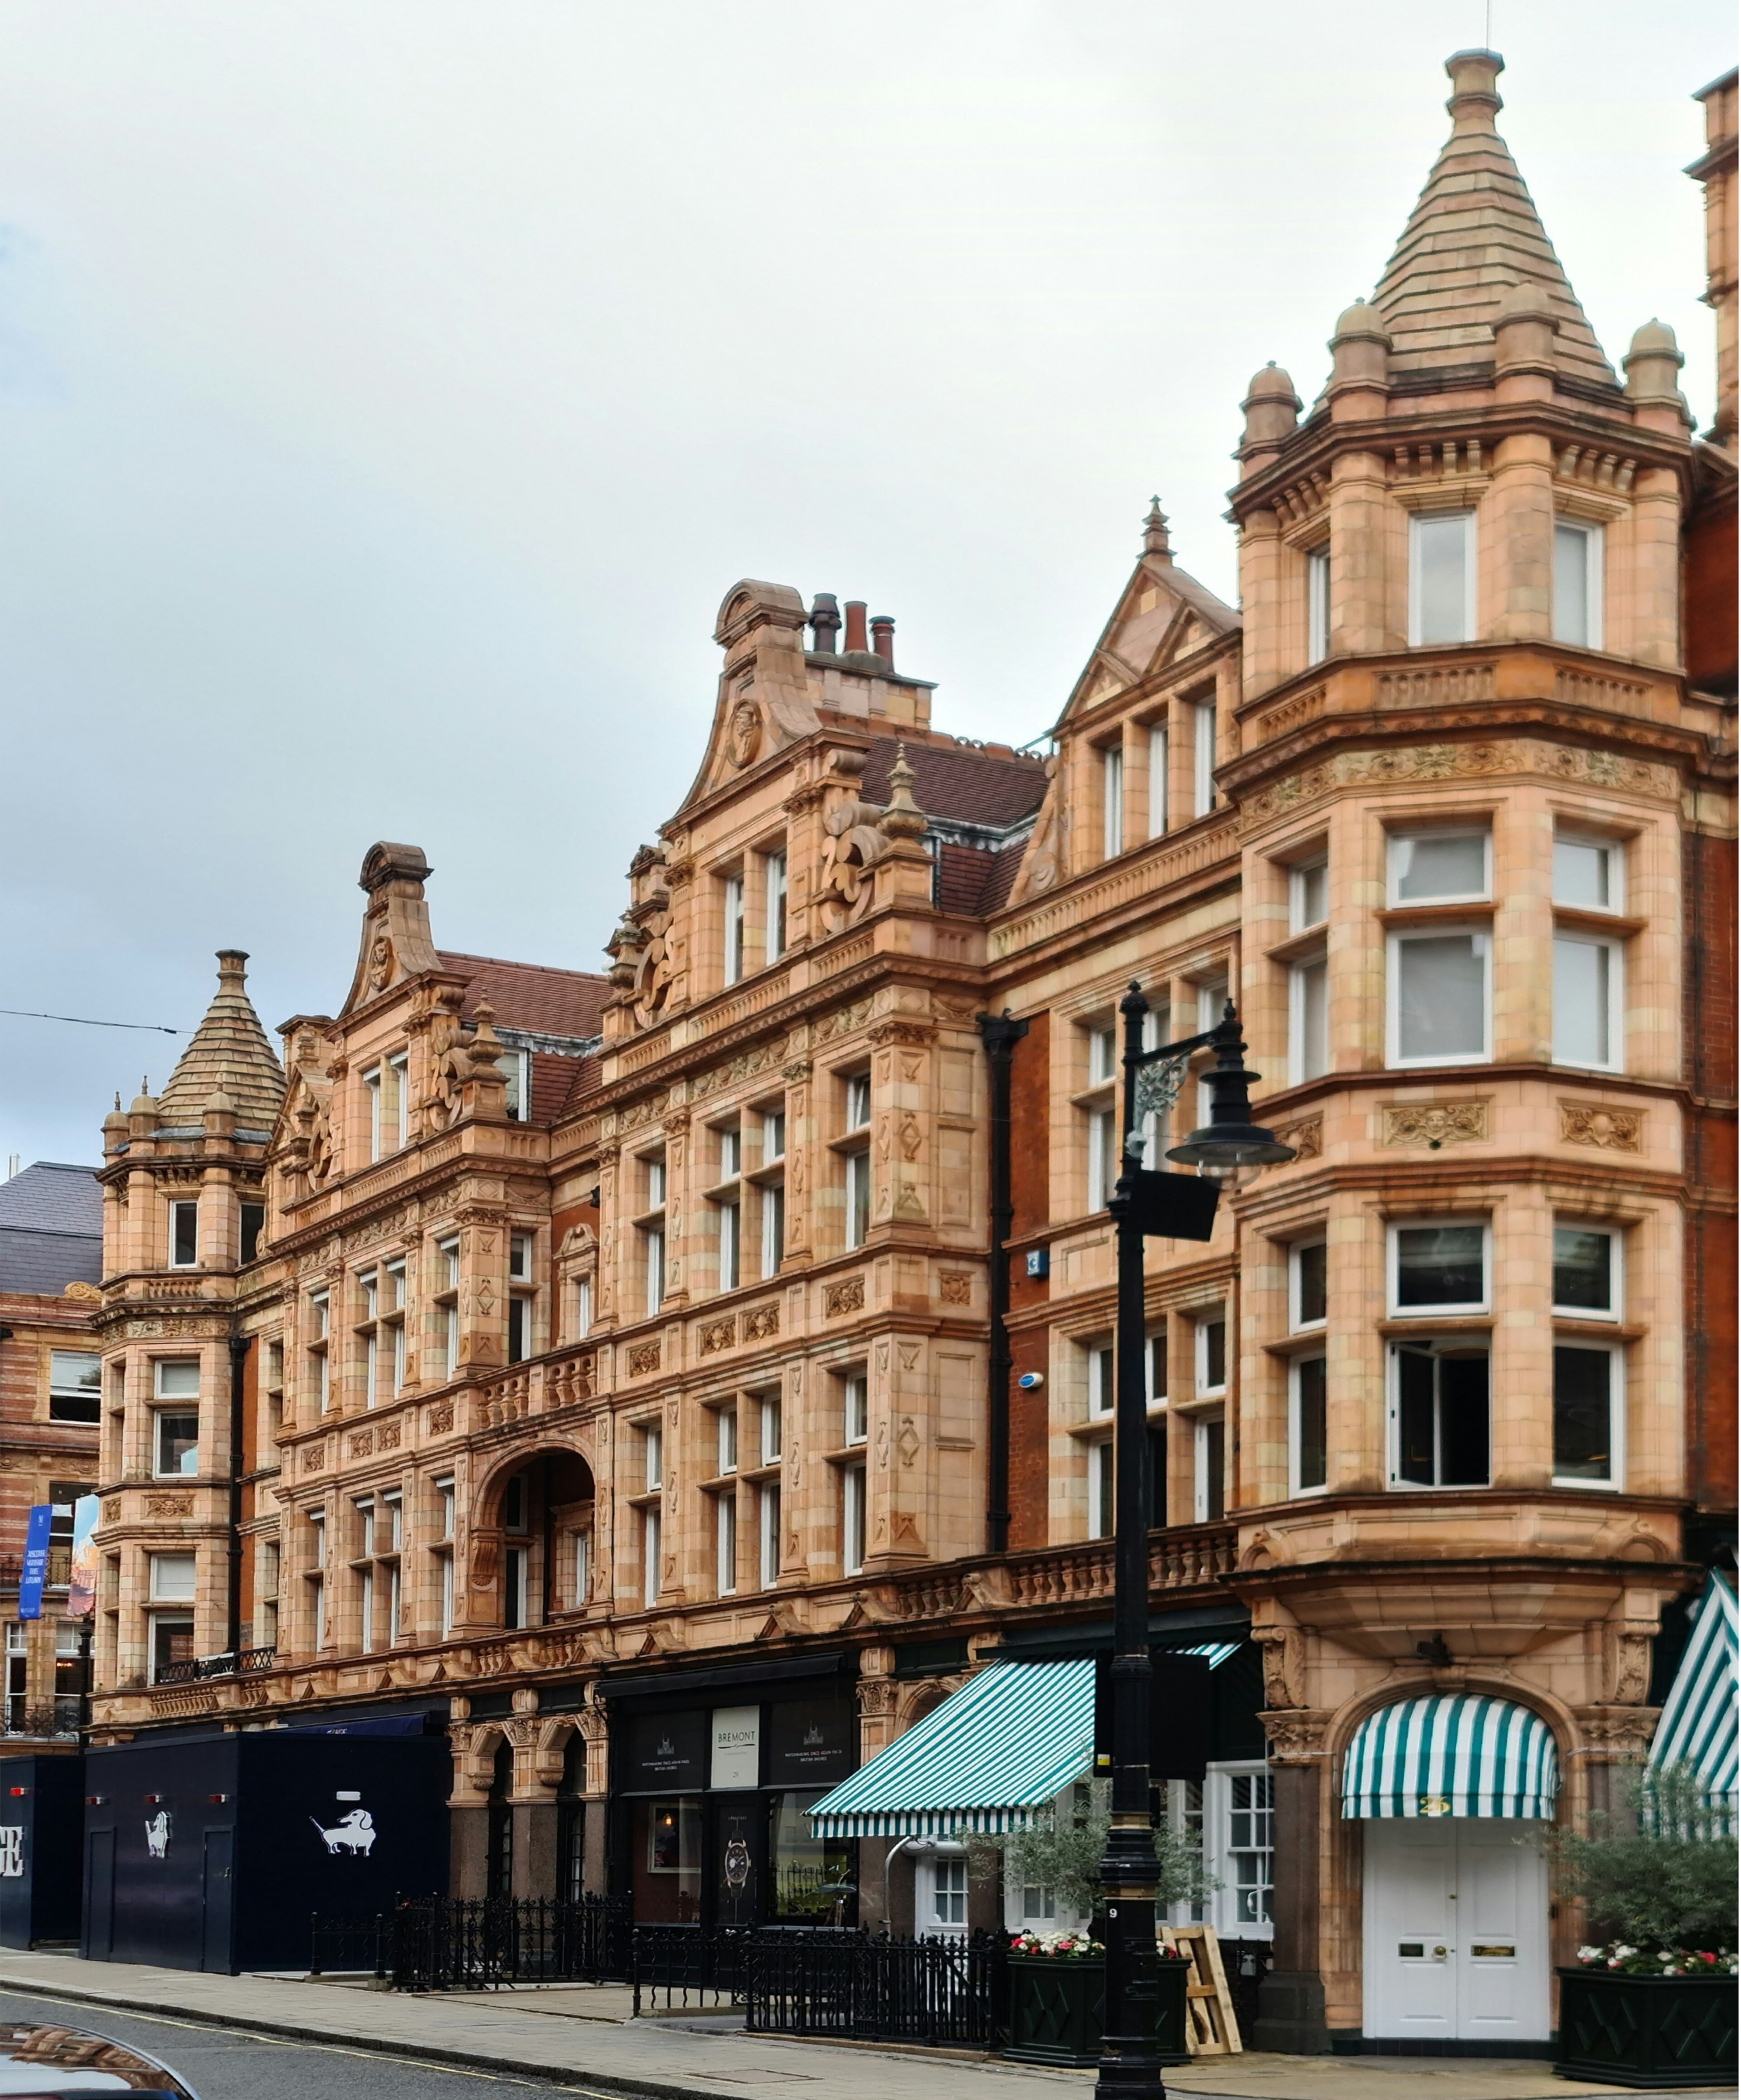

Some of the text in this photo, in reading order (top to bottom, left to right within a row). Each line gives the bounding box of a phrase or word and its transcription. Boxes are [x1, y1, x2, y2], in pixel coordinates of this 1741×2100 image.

[718, 1731, 755, 1742] BREMONT
[1420, 1796, 1450, 1813] 26
[1109, 1908, 1118, 1918] 9
